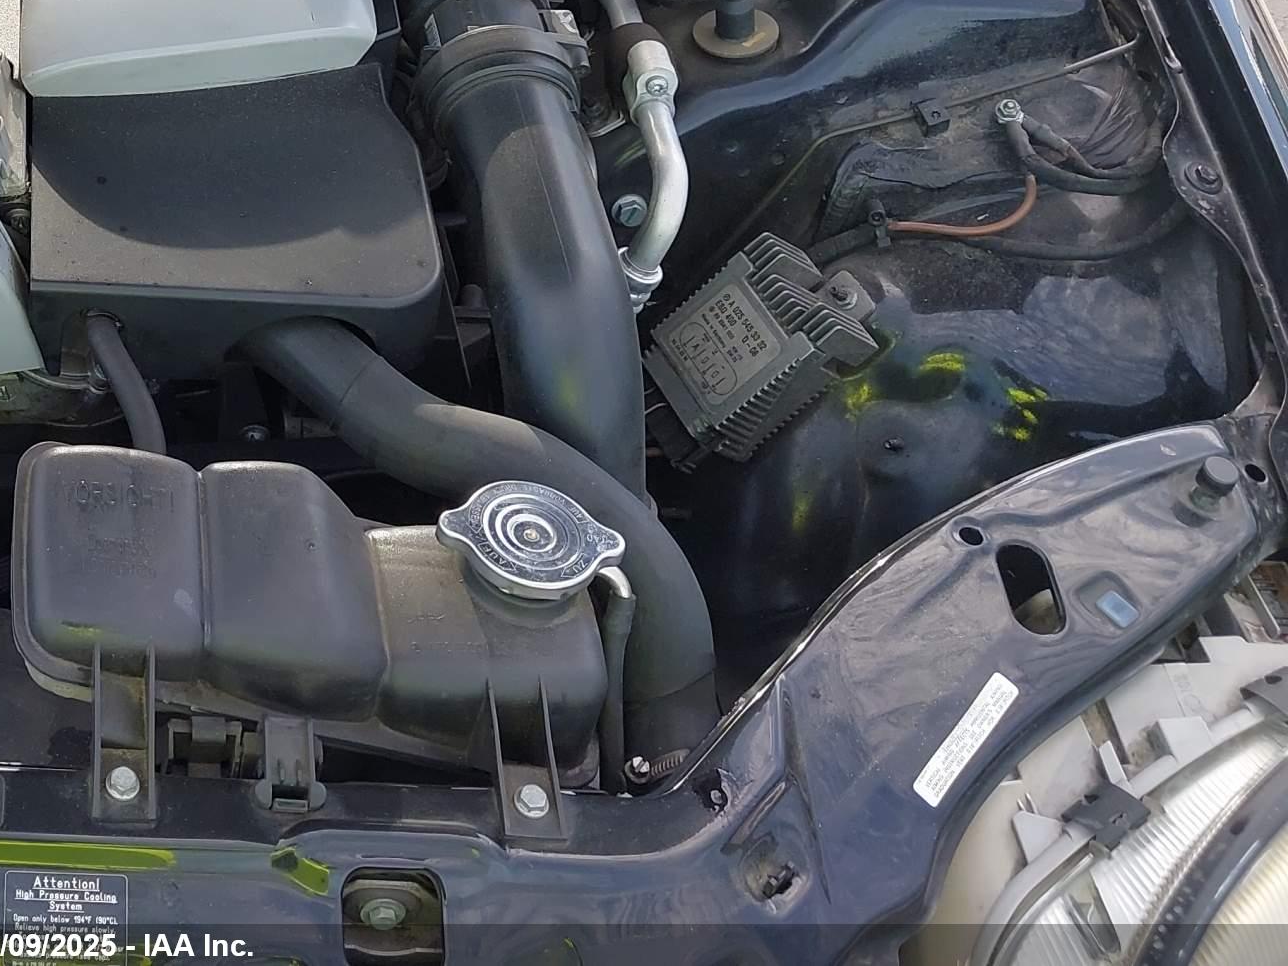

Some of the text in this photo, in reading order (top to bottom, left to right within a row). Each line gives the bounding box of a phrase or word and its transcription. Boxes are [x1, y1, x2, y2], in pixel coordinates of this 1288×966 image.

[483, 544, 506, 566] AUF
[33, 875, 101, 890] Attention!
[15, 889, 118, 904] High Pressure Cooling
[49, 901, 83, 912] System
[13, 914, 29, 923] Open
[31, 914, 47, 924] only
[50, 914, 71, 923] below
[60, 925, 88, 934] pressure
